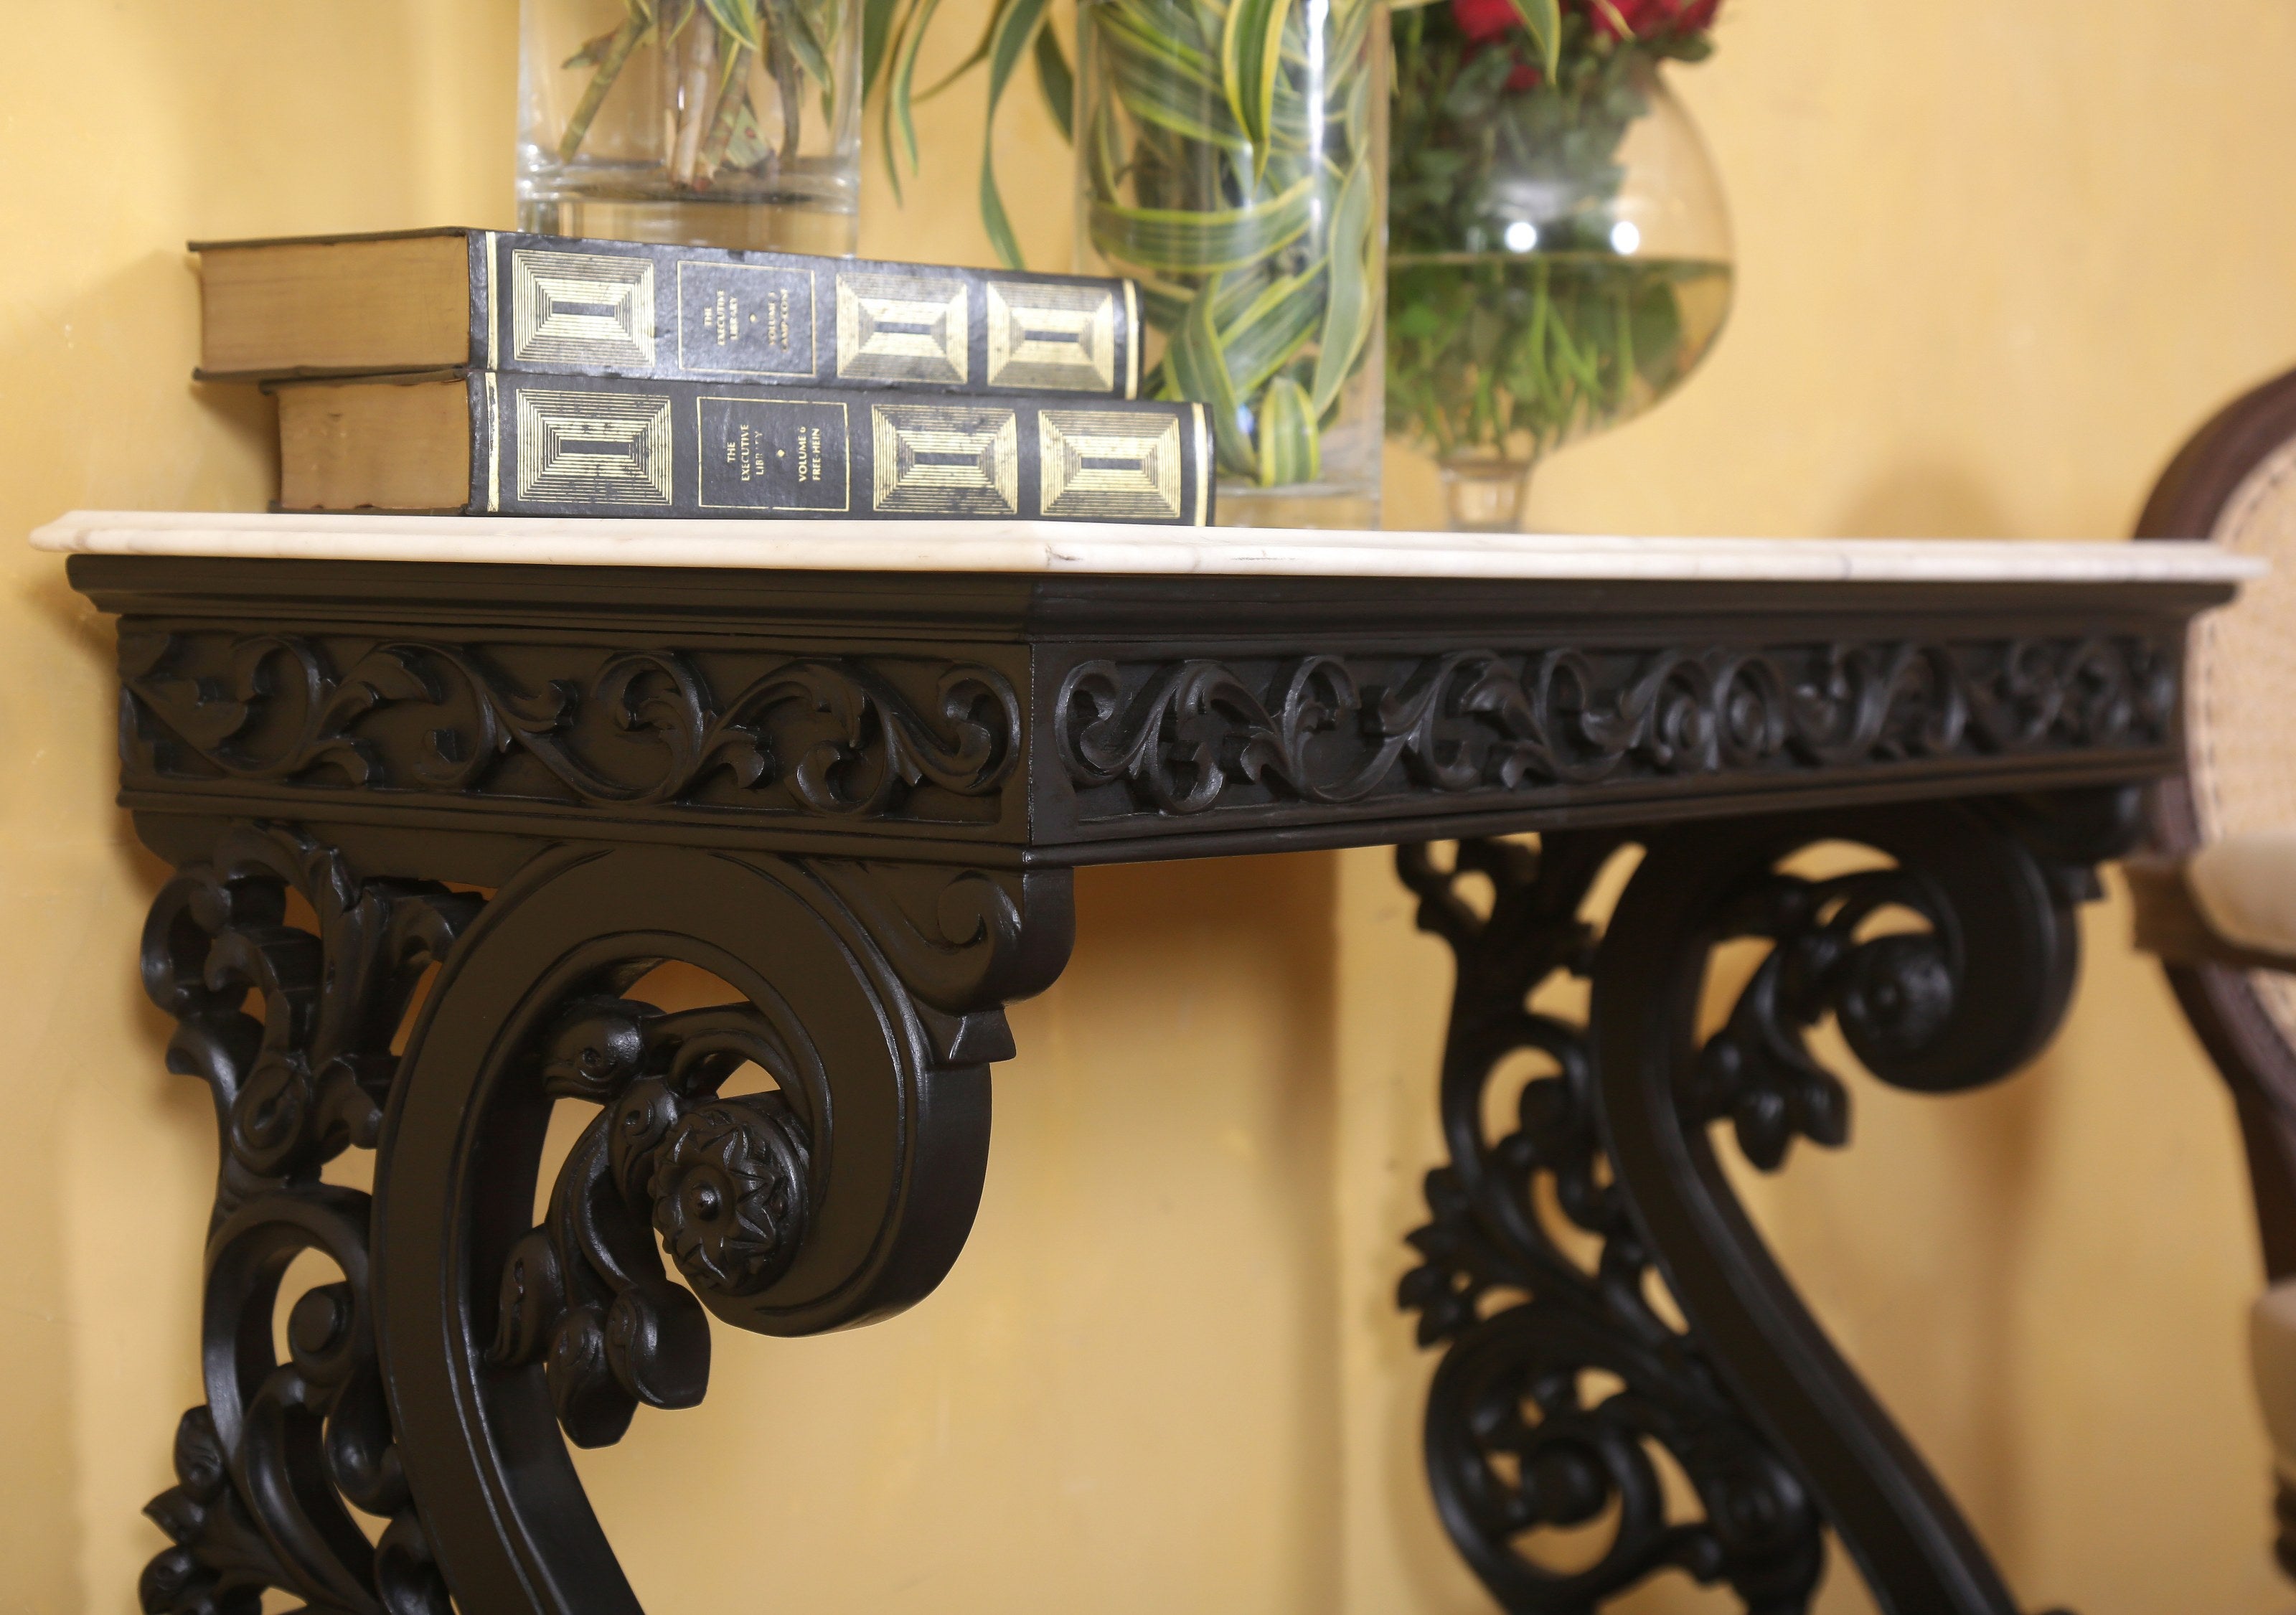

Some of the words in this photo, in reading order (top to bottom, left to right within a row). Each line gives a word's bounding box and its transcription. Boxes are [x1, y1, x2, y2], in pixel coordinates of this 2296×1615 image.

[704, 306, 712, 327] THE
[717, 290, 725, 346] EXECUTIVE
[730, 297, 738, 340] LIBRARY
[768, 301, 776, 346] VOLUME
[727, 442, 736, 463] THE
[740, 424, 751, 482] EXECUTIVE
[755, 430, 764, 475] LIBRY
[799, 435, 808, 482] VOLUME
[812, 428, 822, 481] FREE-HEIN
